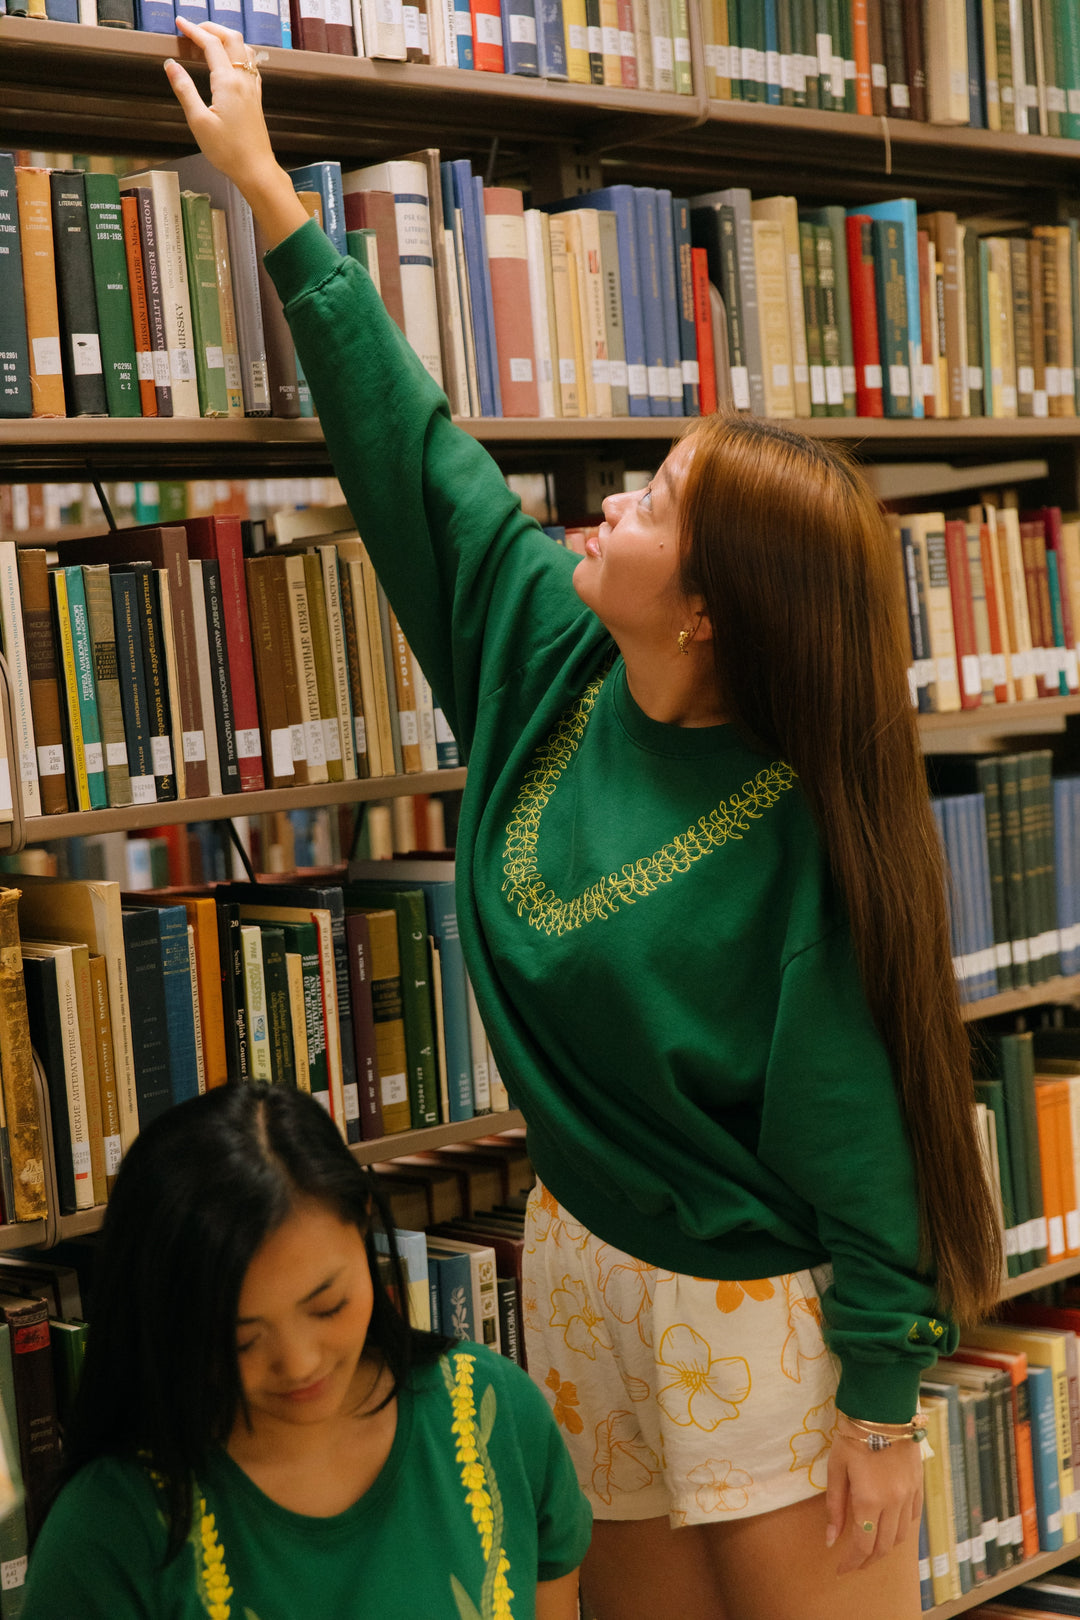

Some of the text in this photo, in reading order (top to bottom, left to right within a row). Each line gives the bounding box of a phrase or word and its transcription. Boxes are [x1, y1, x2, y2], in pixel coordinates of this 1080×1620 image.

[133, 256, 147, 310] LITERATURE
[143, 199, 166, 351] MODERN RUSSIAN LITERATU
[7, 565, 15, 596] WESTERN
[208, 575, 217, 594] МИРА
[327, 564, 339, 614] ВОСТОКА
[10, 597, 19, 648] PHILOSOPHICAL
[73, 604, 82, 635] НОВОЙ
[210, 596, 222, 629] ДРЕВНЕГО
[295, 593, 310, 634] СВЯЗИ
[145, 617, 158, 675] зарубежные
[214, 629, 225, 666] ЛИТЕРАТУР
[333, 616, 344, 655] СТРАНАХ
[15, 649, 23, 678] SYSTEMS
[77, 640, 88, 672] ЛИЦОМ
[67, 661, 77, 693] РУССКОЙ
[152, 675, 159, 687] ее
[218, 666, 230, 712] ВЗАИМОСВЯЗИ
[337, 666, 350, 716] КЛАССИКА
[18, 688, 26, 717] RUSSIAN
[223, 720, 235, 760] ТИПОЛОГИЯ
[338, 720, 353, 762] РУССКАЯ
[230, 919, 240, 928] 20
[233, 949, 241, 976] Sendich
[249, 941, 257, 959] THE
[246, 961, 262, 1012] POSSESSED
[316, 974, 324, 1018] ARTISTIC
[193, 999, 202, 1050] ЛИТЕРАТУРА
[303, 976, 316, 1065] OF CREATIVE WORK
[309, 975, 321, 1055] AND DIALECTICS
[236, 1008, 247, 1073] English Counter
[256, 1047, 266, 1068] ELIF
[65, 993, 83, 1143] ЯНСКИЕ ЛИТЕРАТУРНЫЕ СВЯЗИ
